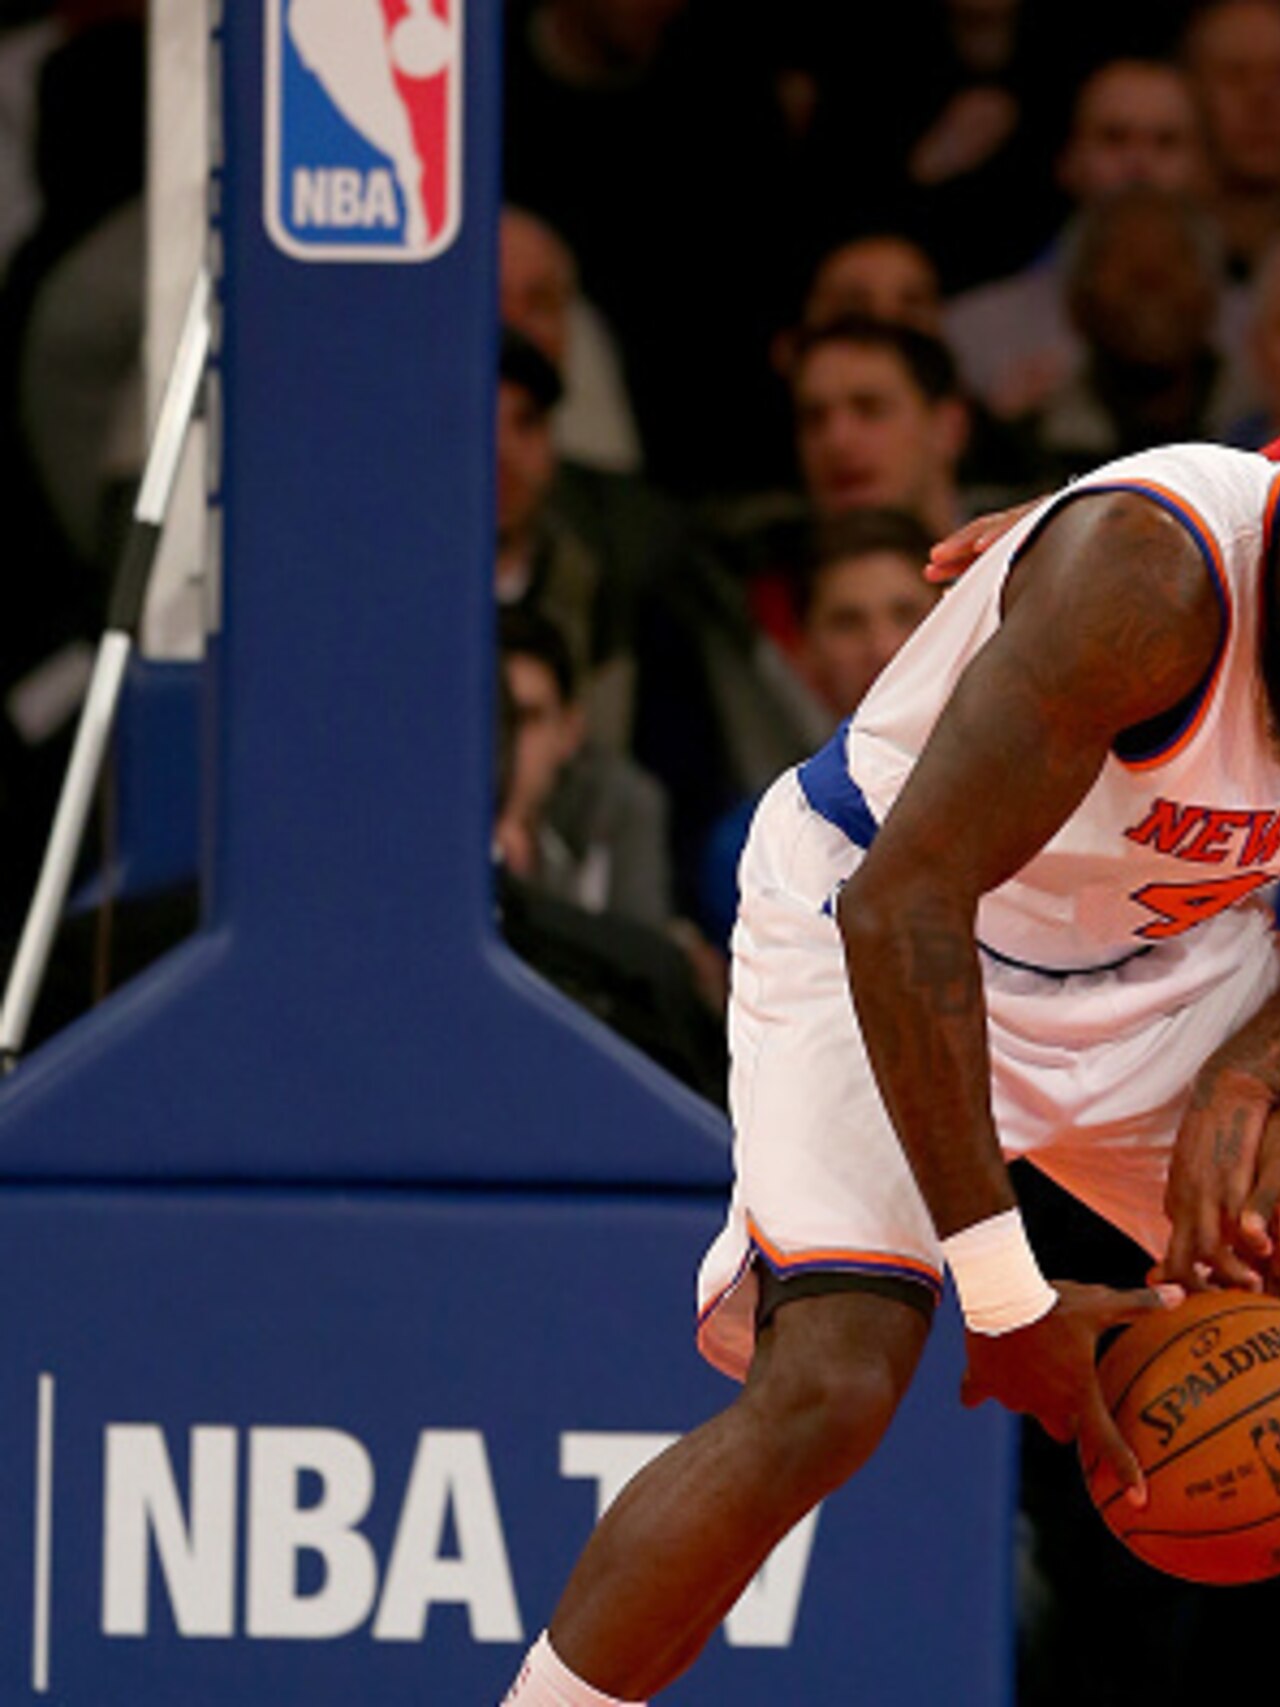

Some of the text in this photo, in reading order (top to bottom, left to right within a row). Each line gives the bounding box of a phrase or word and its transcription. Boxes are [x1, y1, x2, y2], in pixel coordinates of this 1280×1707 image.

[292, 166, 399, 229] NBA
[1130, 870, 1279, 939] 4
[101, 1423, 524, 1643] NBA
